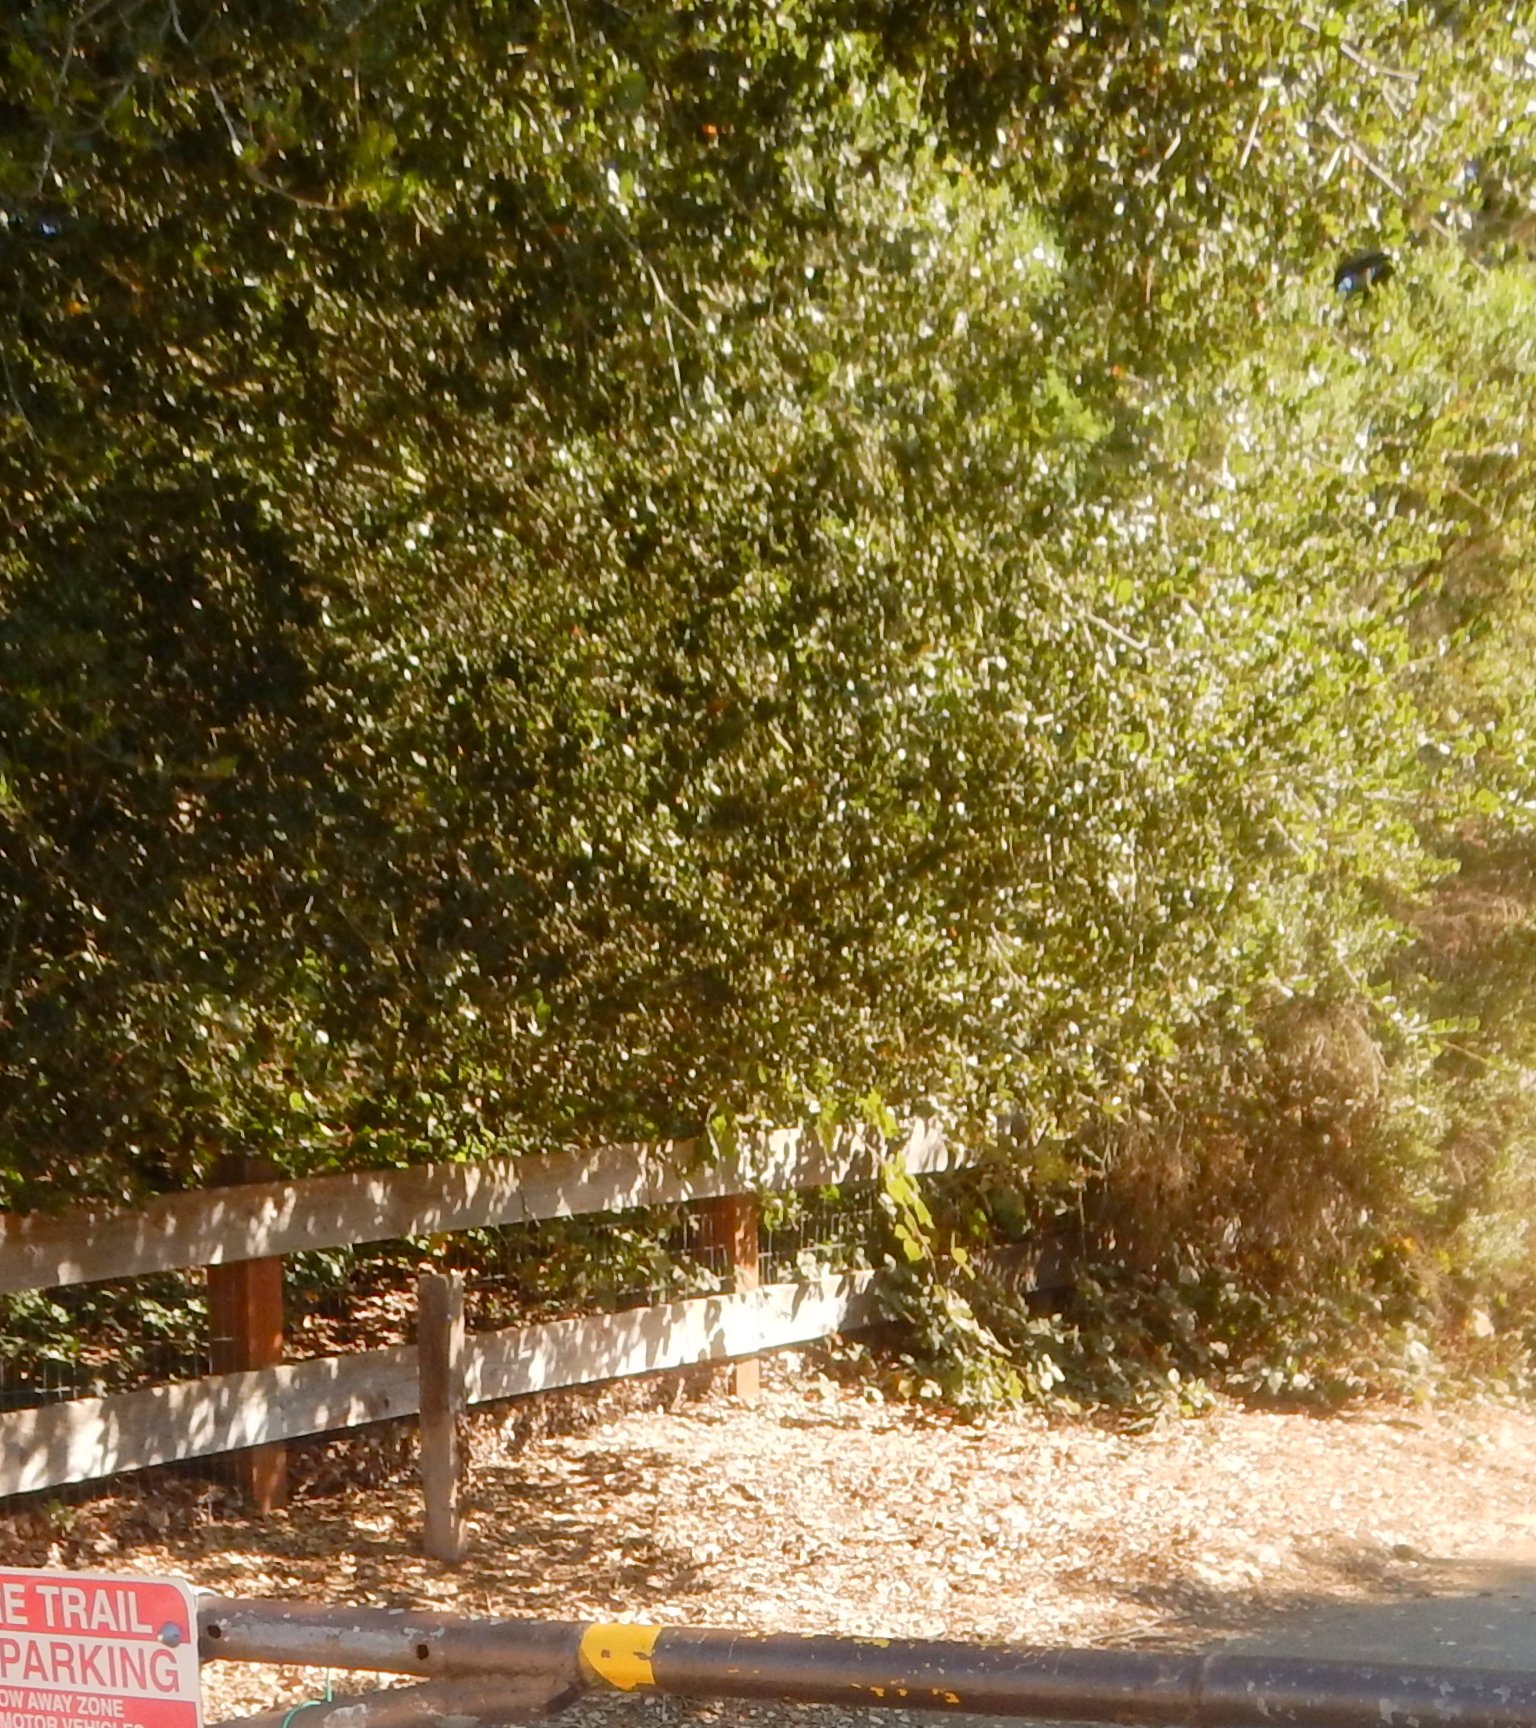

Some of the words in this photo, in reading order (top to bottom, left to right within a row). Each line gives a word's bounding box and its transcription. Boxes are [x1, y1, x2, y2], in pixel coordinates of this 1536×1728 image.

[37, 1585, 153, 1634] TRAIL
[0, 1637, 180, 1693] PARKING
[28, 1692, 73, 1713] AWAY
[77, 1696, 125, 1718] ZONE
